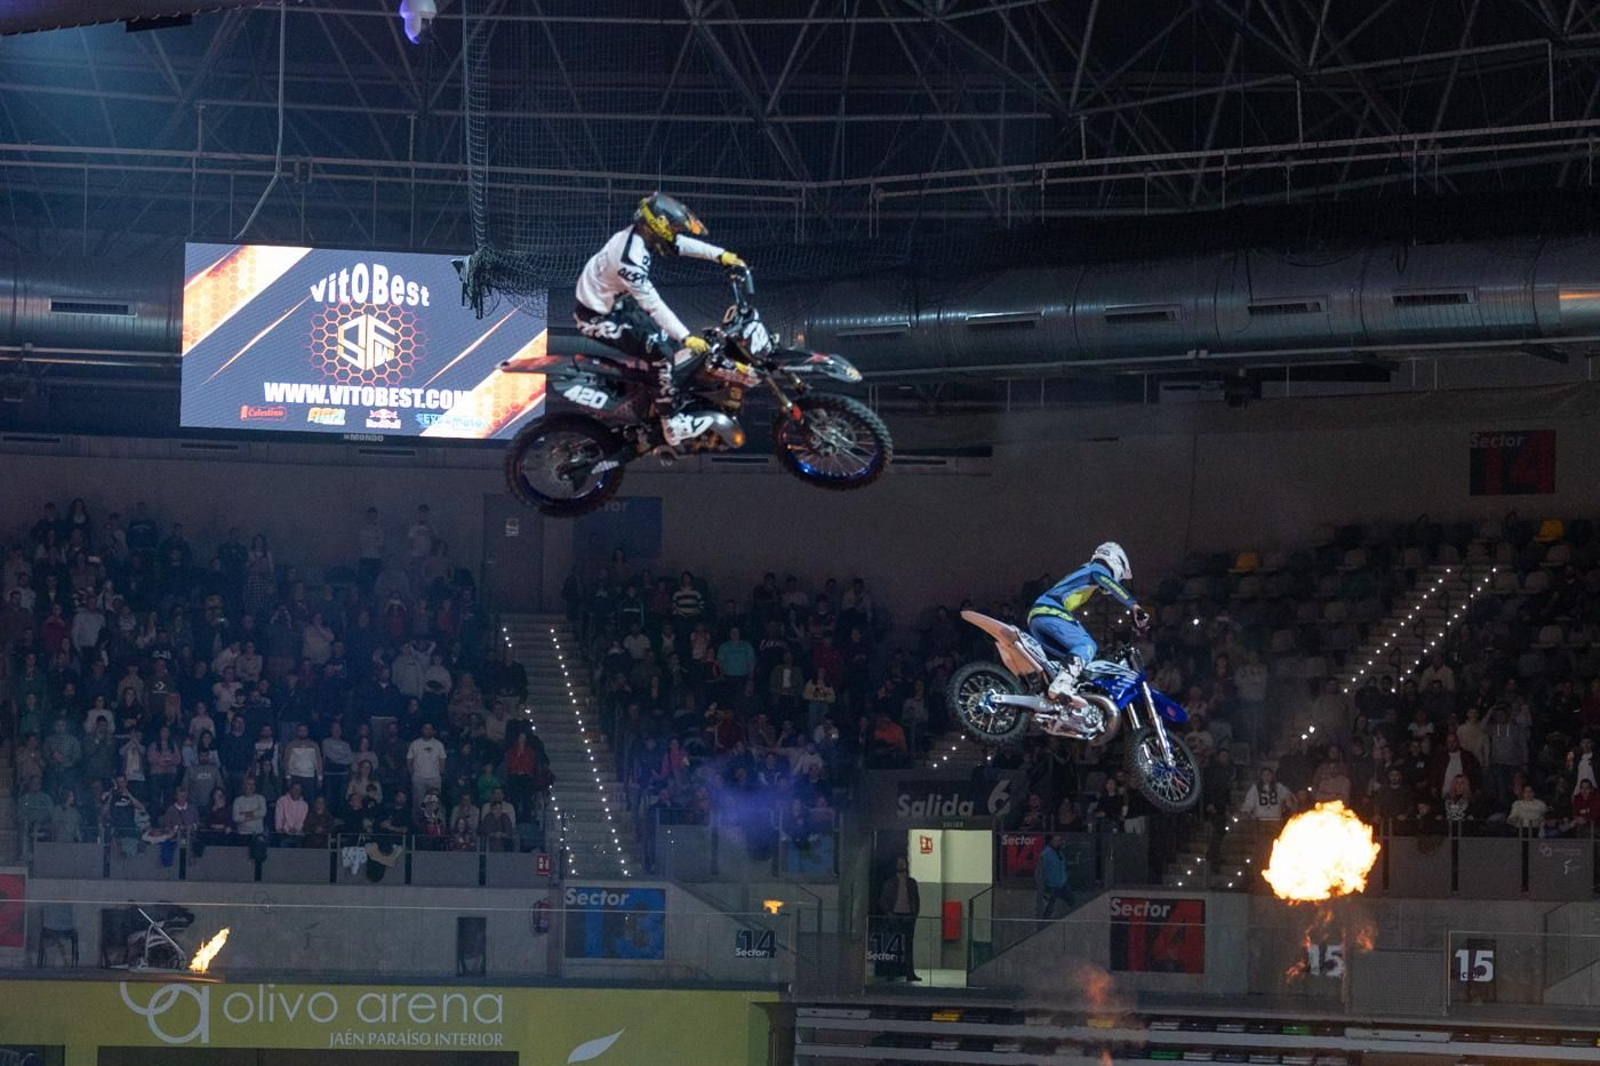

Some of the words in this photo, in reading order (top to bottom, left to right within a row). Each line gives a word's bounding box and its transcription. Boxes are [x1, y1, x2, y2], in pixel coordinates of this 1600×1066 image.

[562, 384, 609, 410] 420
[1470, 433, 1526, 448] Sector
[896, 793, 975, 817] Salida
[987, 779, 1011, 817] 6
[1002, 834, 1037, 846] Sector
[566, 888, 631, 906] Sector
[1110, 898, 1171, 917] Sector
[738, 930, 777, 958] 14
[1127, 898, 1203, 973] 14
[735, 947, 768, 957] Sector
[1309, 944, 1346, 977] 15
[1454, 949, 1494, 982] 15
[223, 984, 338, 1024] olivo
[357, 991, 503, 1024] arena
[329, 1028, 365, 1047] JAÉN
[368, 1029, 431, 1047] PARAÍSO
[434, 1032, 503, 1047] INTERIOR
